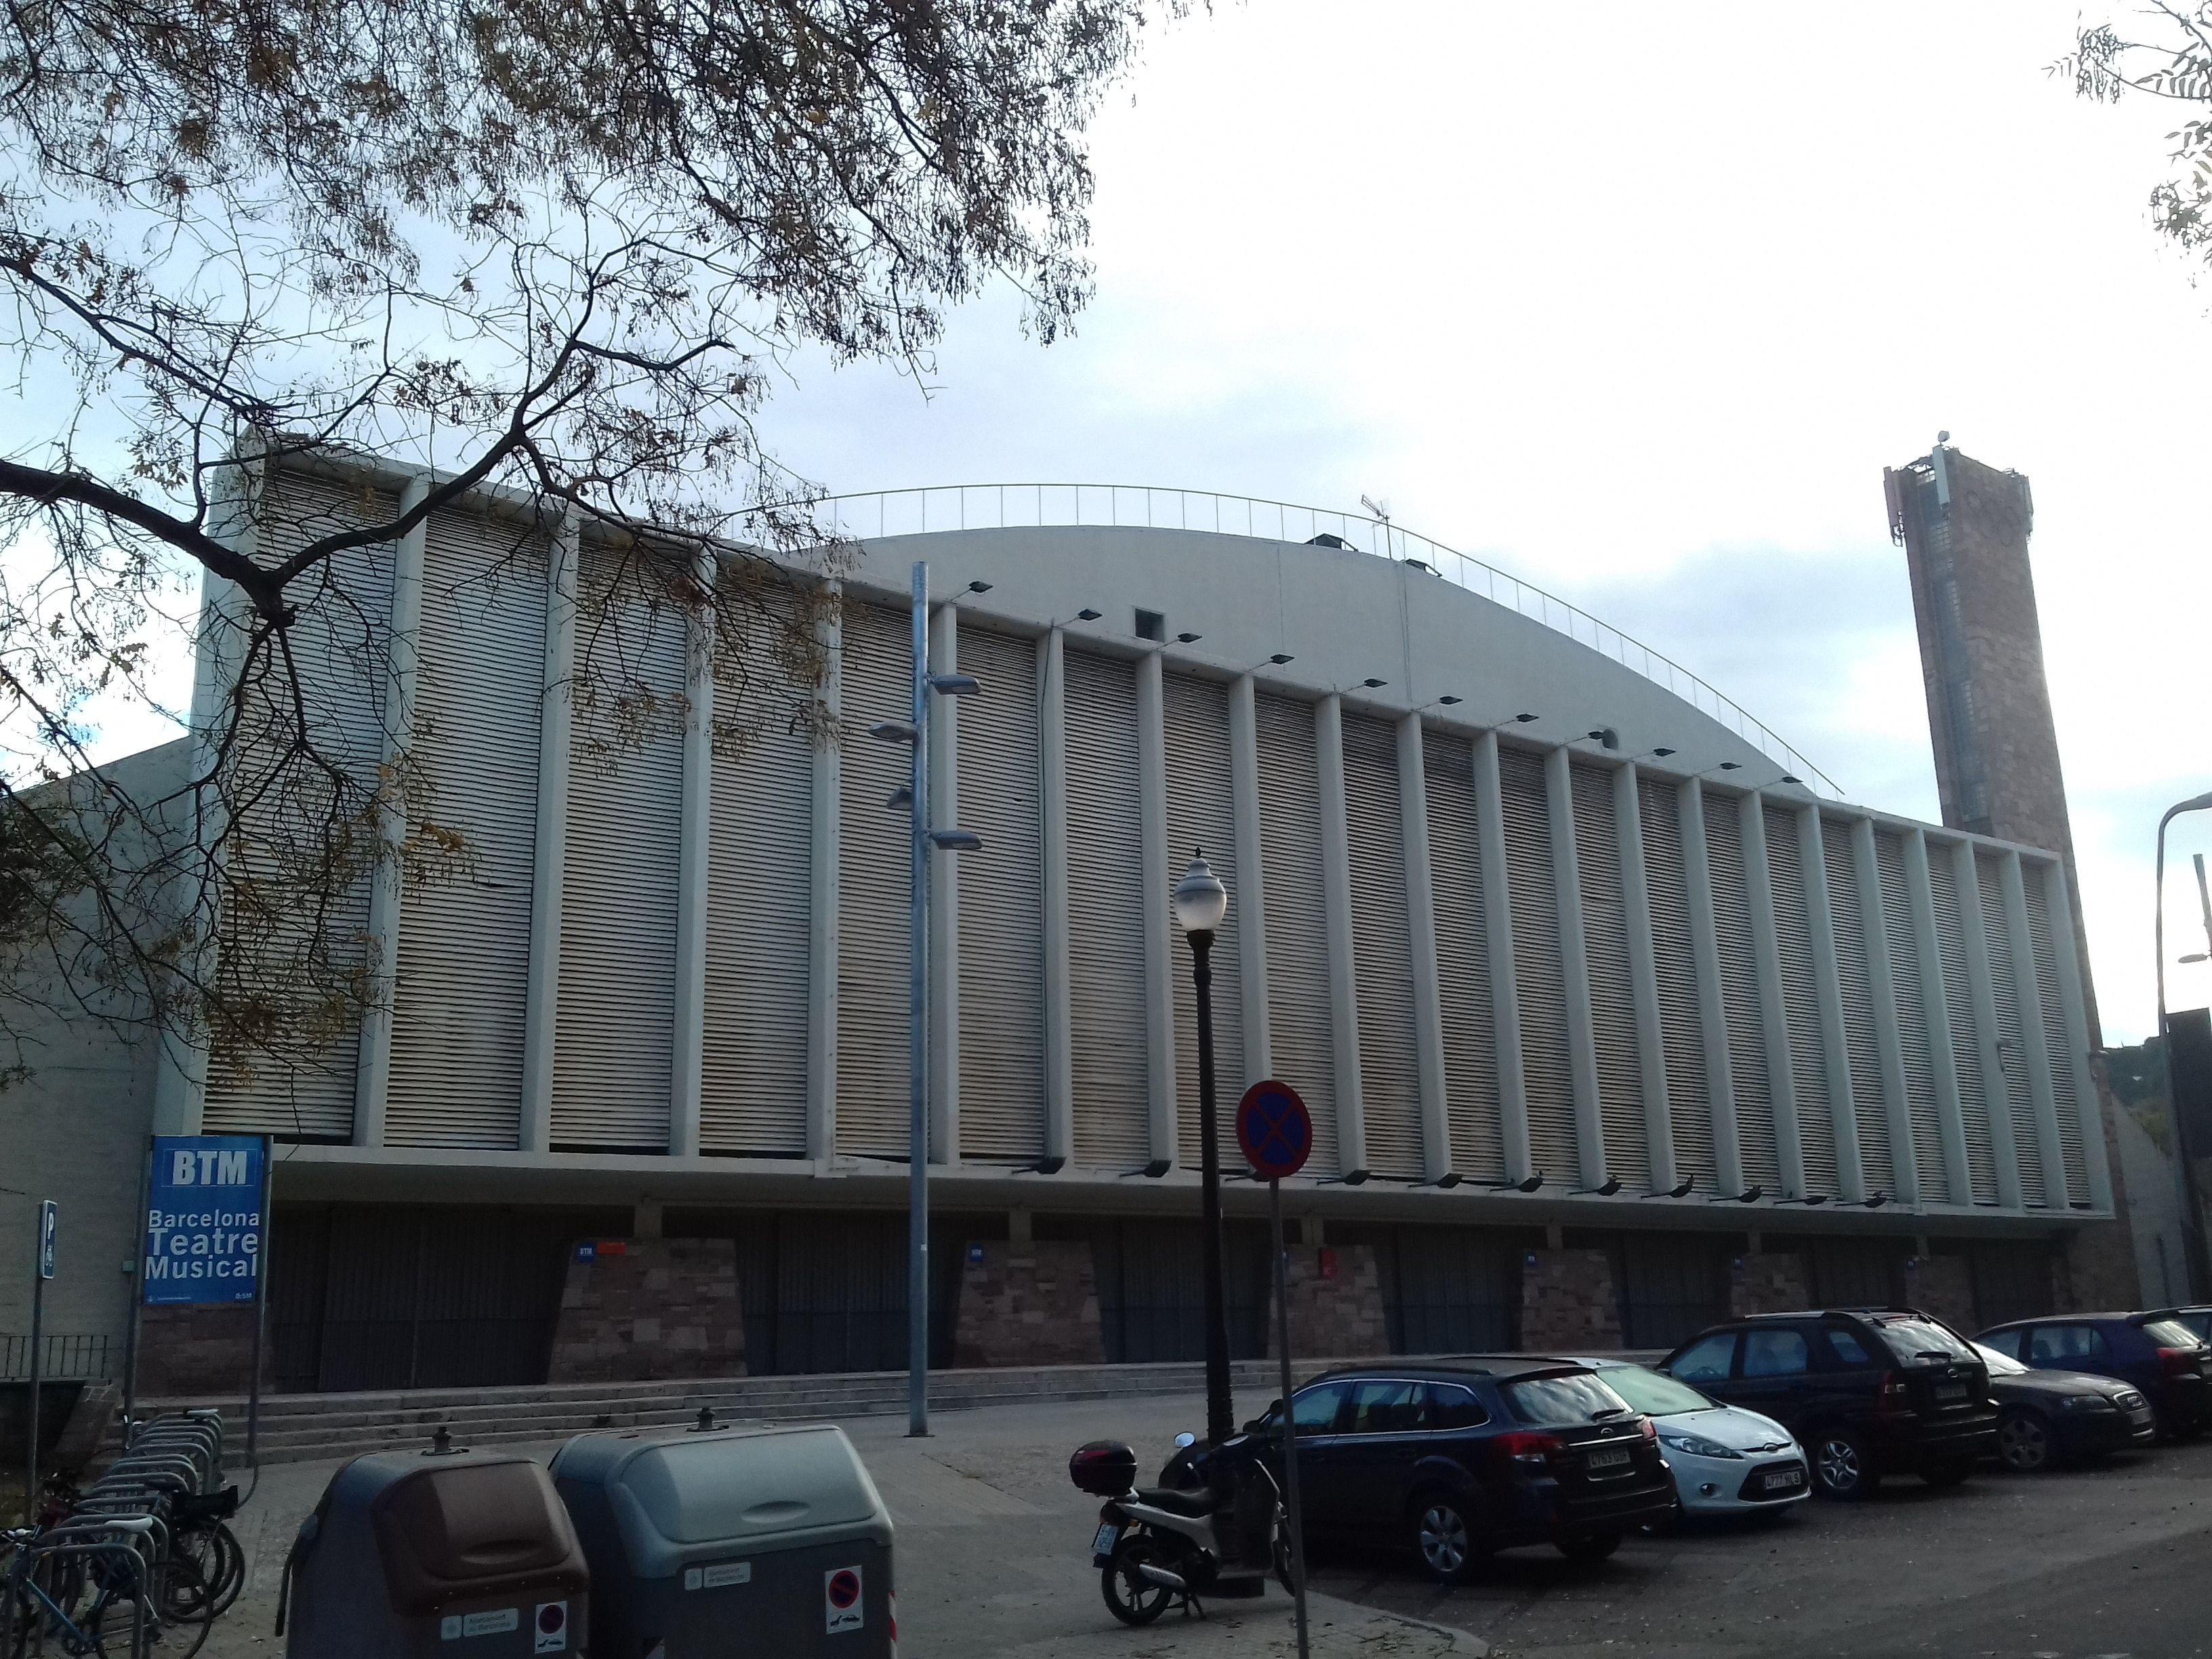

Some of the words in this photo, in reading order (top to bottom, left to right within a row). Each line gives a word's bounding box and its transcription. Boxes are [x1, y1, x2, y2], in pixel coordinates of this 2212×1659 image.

[172, 1150, 247, 1185] BTM
[47, 1212, 54, 1240] P
[148, 1209, 260, 1227] Barcelona
[148, 1227, 258, 1256] Teatre
[144, 1254, 258, 1279] Musical
